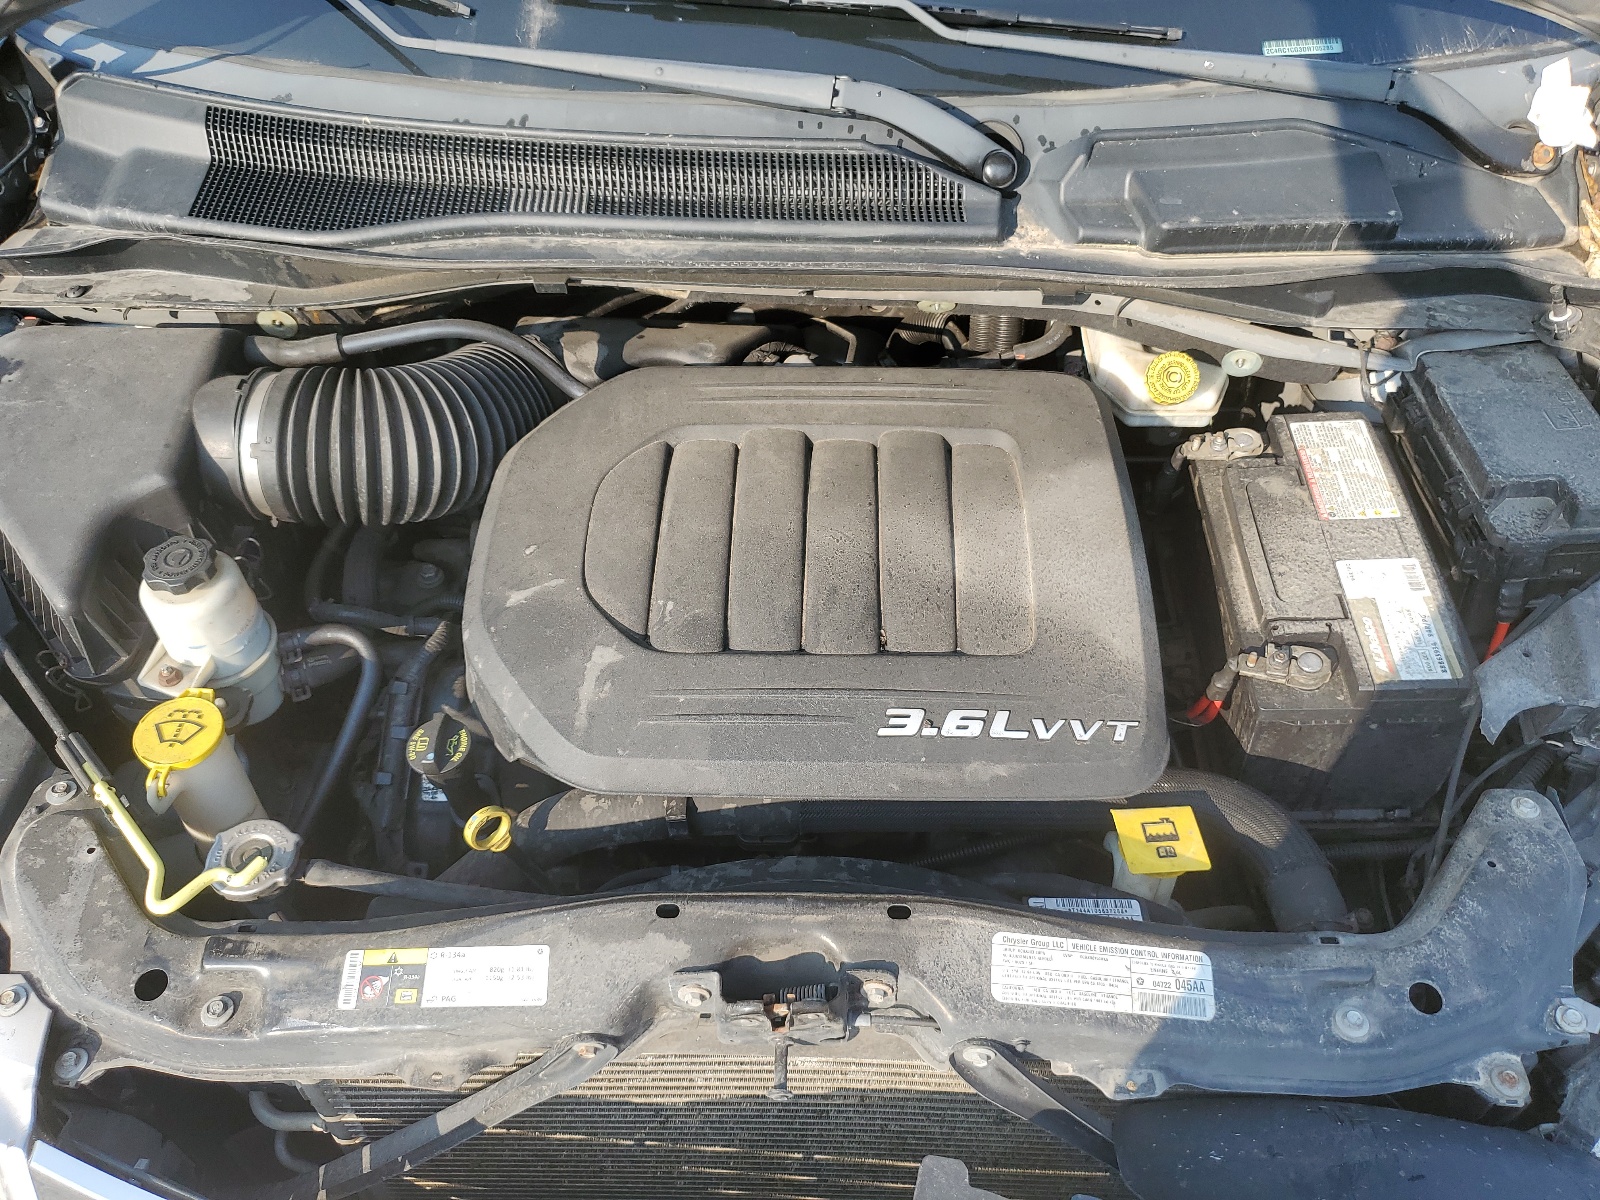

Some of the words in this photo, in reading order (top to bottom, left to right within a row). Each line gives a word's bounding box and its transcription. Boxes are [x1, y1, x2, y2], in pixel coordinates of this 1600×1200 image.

[876, 707, 1031, 739] 3.6L
[1031, 718, 1140, 742] VVT
[412, 728, 425, 741] SAE
[458, 728, 468, 752] ENGINE
[450, 752, 463, 762] OIL
[1002, 935, 1028, 945] Chrysler
[1030, 938, 1050, 948] Group
[1052, 940, 1064, 949] LLC
[1071, 942, 1097, 952] VEHICLE
[1099, 944, 1129, 955] EMISSION
[1130, 948, 1159, 959] CONTROL
[1161, 951, 1203, 963] INFORMATION
[1152, 980, 1172, 989] 04722
[1174, 978, 1206, 993] 045AA
[441, 995, 457, 1003] PAG
